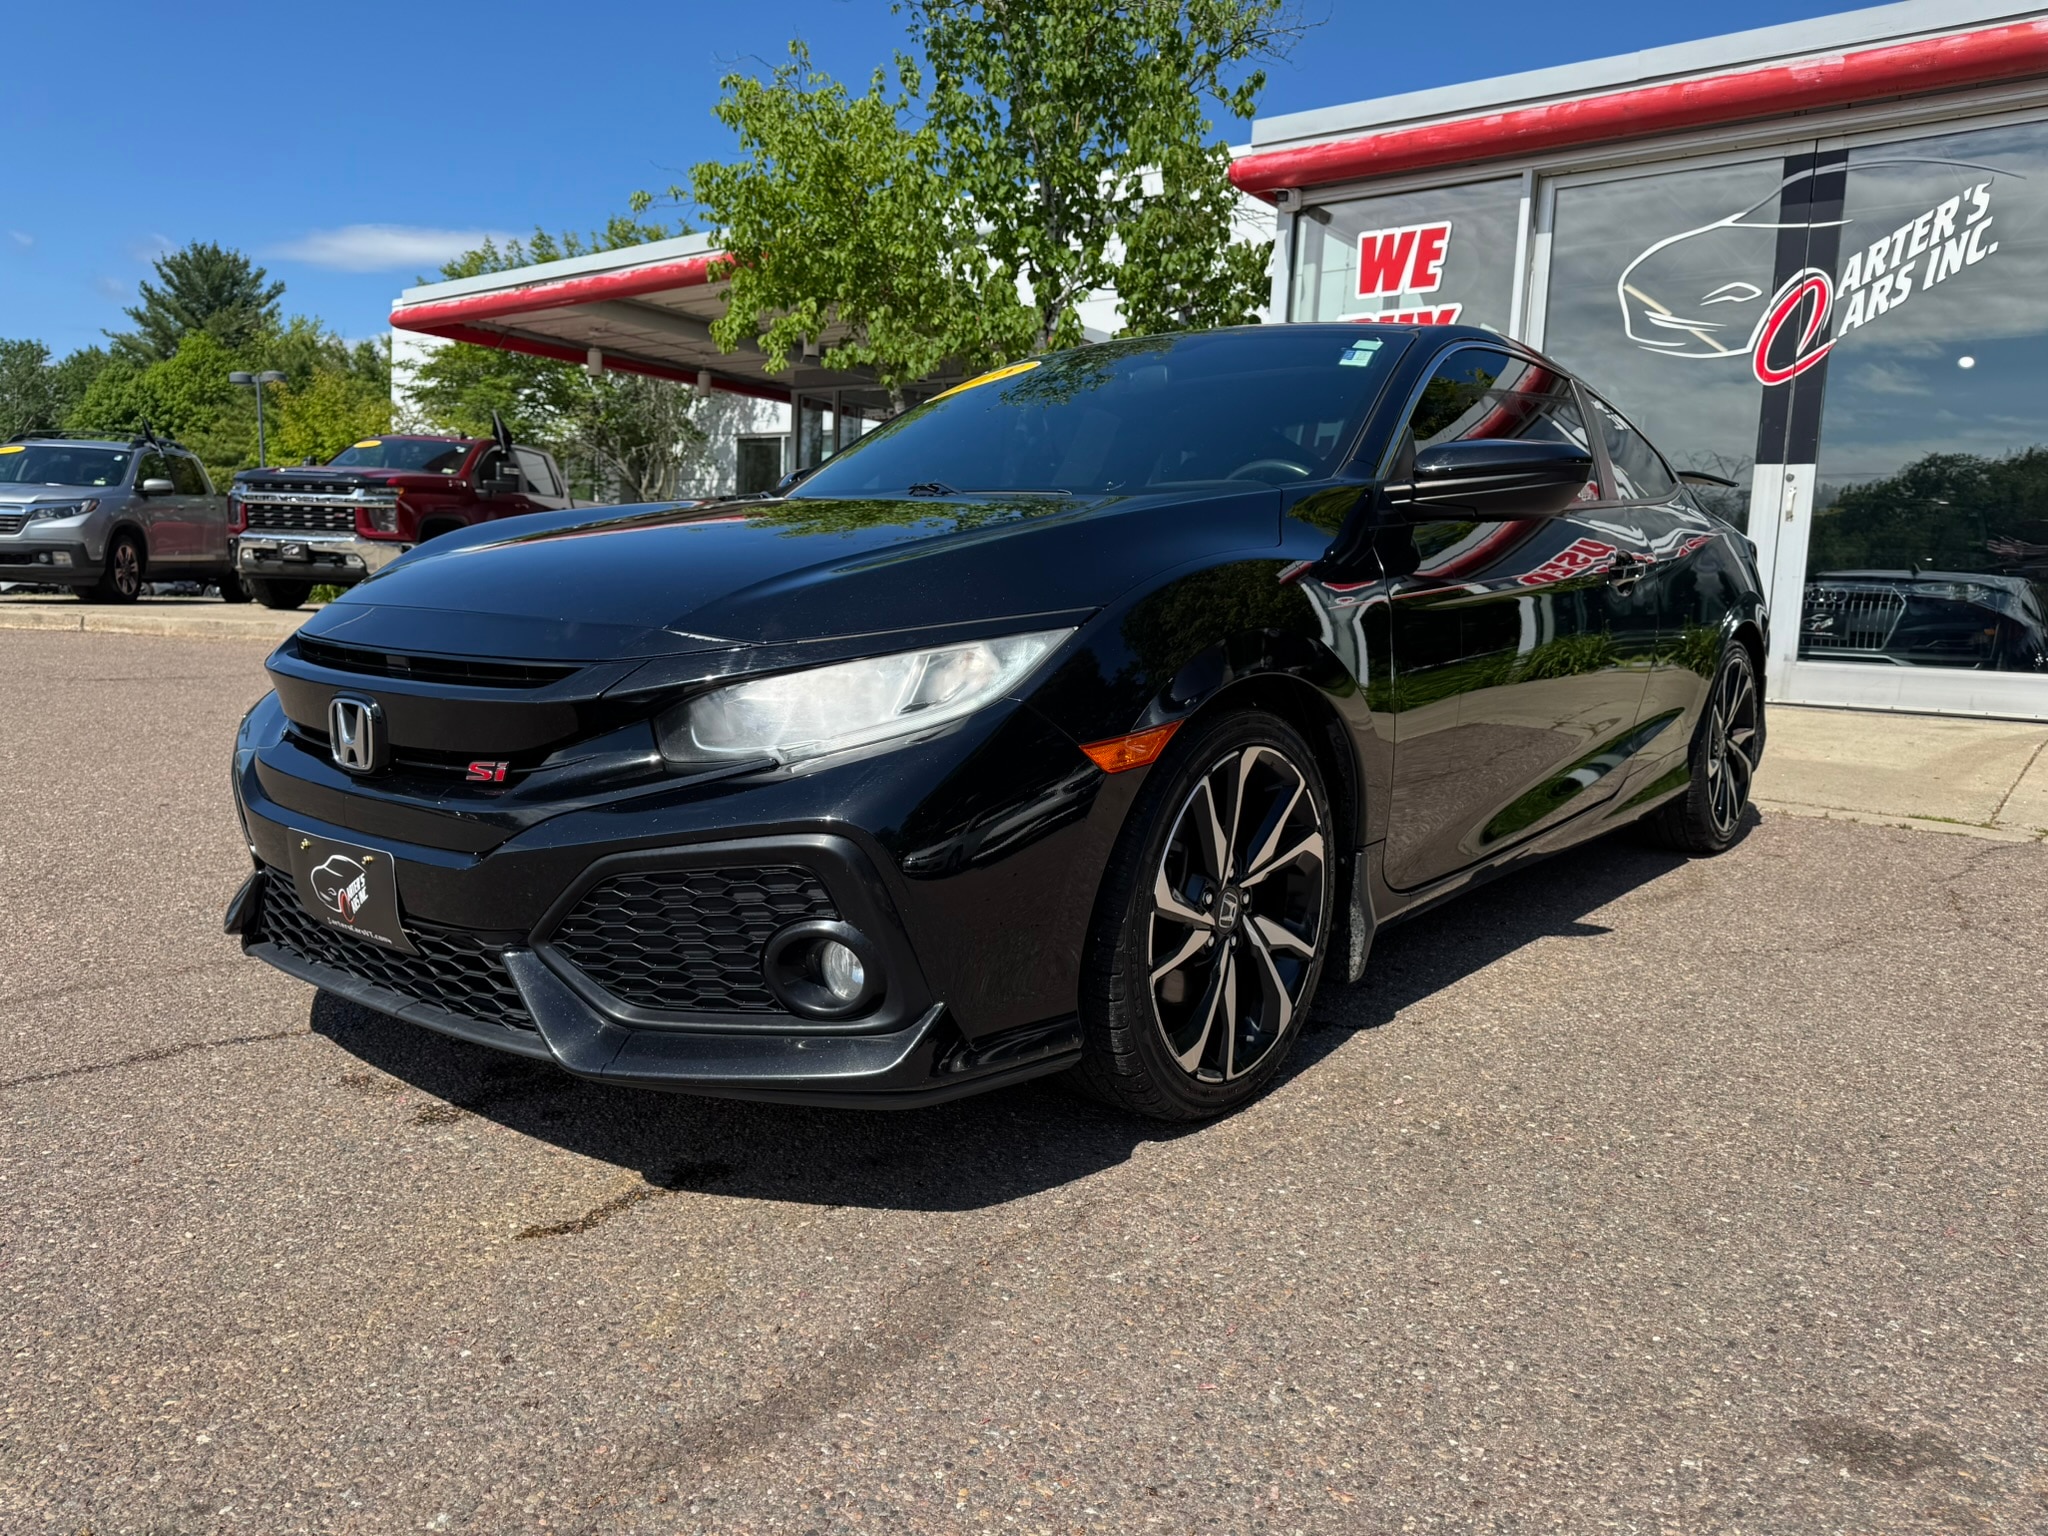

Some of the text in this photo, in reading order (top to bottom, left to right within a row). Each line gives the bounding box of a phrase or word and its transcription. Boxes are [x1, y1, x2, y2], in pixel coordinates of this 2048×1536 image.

[1357, 222, 1450, 297] WE
[1921, 216, 1999, 291] INC.
[466, 761, 509, 781] Si
